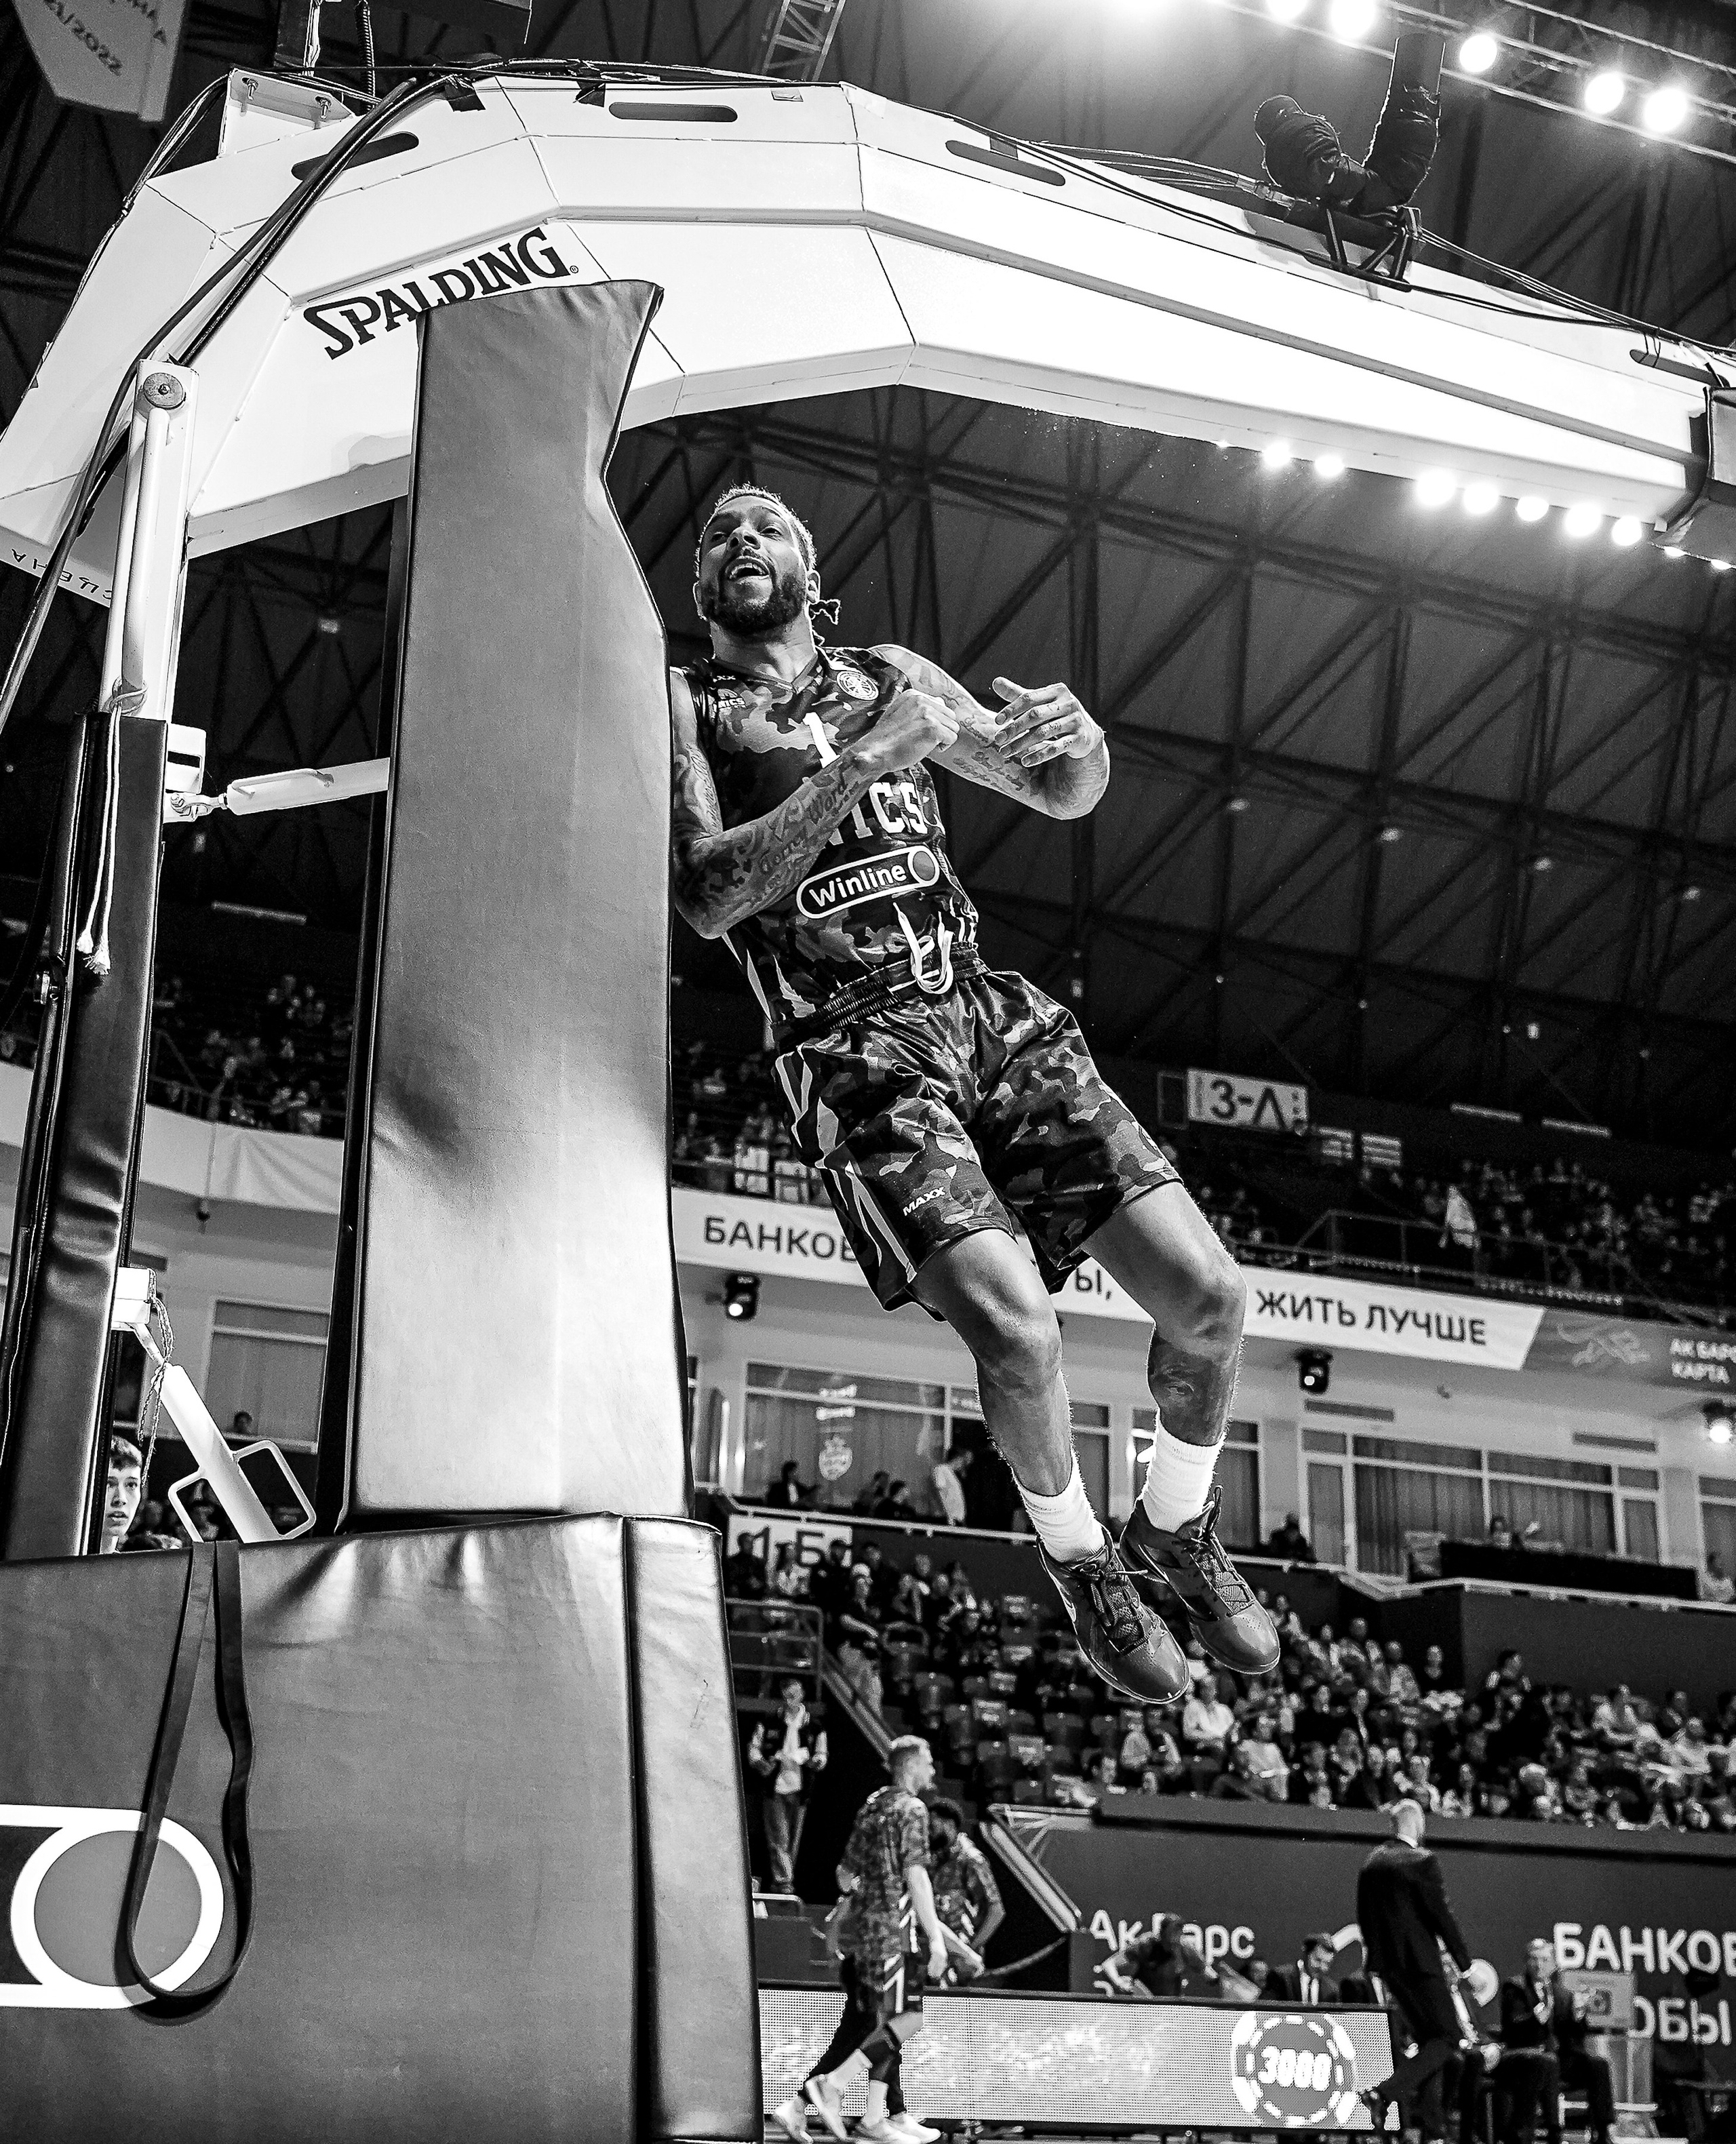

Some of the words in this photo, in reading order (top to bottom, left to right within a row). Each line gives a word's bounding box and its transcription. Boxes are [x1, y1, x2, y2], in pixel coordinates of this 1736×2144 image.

[303, 227, 571, 360] SPALDING
[829, 782, 928, 846] ICS
[809, 865, 907, 907] Winline
[903, 1186, 946, 1216] MAXX
[1255, 1289, 1357, 1327] ЖИТЬ
[1364, 1304, 1487, 1346] ЛУЧШЕ
[1258, 2046, 1331, 2092] 3000
